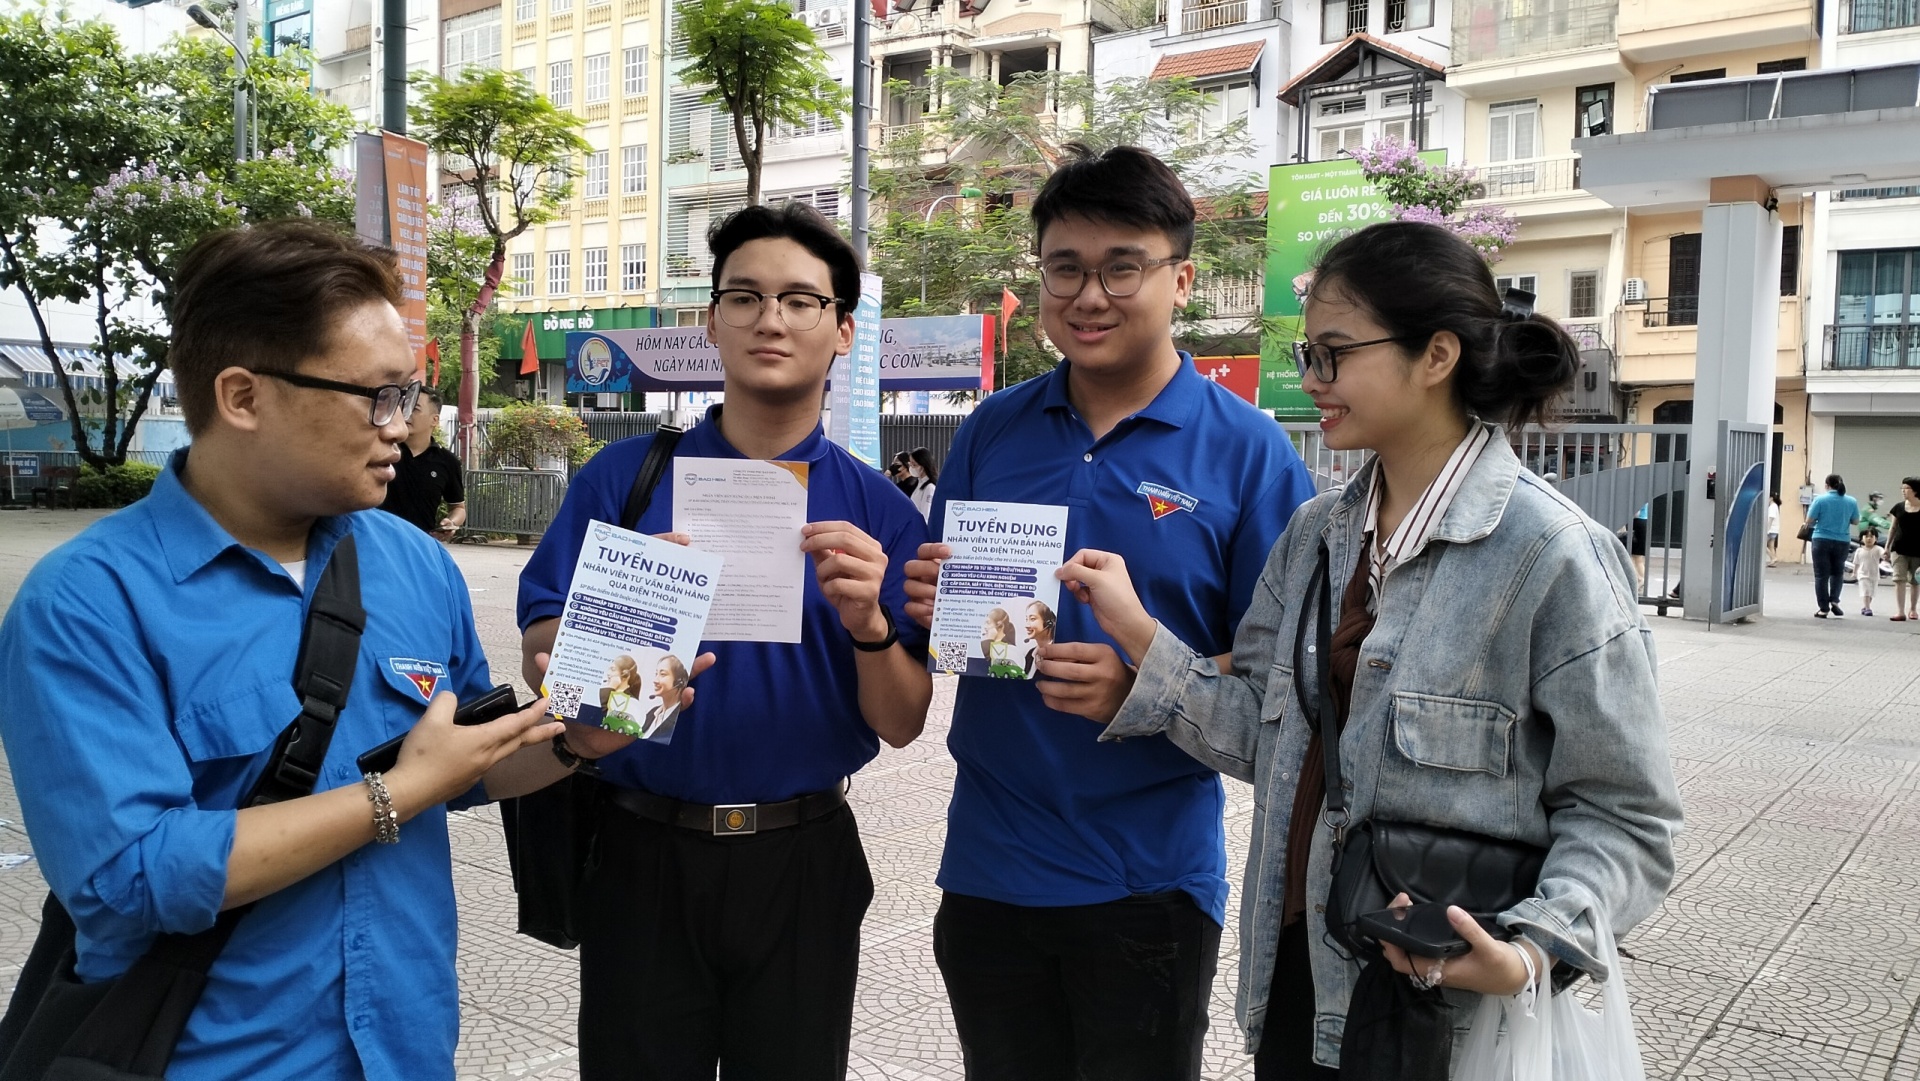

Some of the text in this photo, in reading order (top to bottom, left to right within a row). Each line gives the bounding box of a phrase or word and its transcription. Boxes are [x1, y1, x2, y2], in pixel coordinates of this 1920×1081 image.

[1301, 187, 1322, 201] GIÁ
[1326, 185, 1358, 199] LUÔN
[1318, 202, 1386, 223] ĐẾN 30%
[1298, 231, 1313, 241] SO
[543, 313, 594, 330] ĐỒNG HỒ
[636, 333, 710, 351] HÔM NAY CÁC
[654, 356, 684, 372] NGÀY
[686, 359, 708, 372] MAI
[1267, 370, 1275, 379] HỆ
[1584, 372, 1597, 392] U
[957, 514, 1057, 538] TUYỂN DỤNG
[989, 545, 1007, 554] ĐIỆN
[1010, 548, 1033, 557] THOẠI
[1002, 537, 1018, 545] VẤN
[1038, 540, 1061, 548] HÀNG
[598, 546, 707, 586] TUYỂN DỤNG
[582, 561, 709, 601] NHÂN VIÊN TƯ VẤN BÁN HÀNG
[608, 579, 677, 604] QUA ĐIỆN THOẠI
